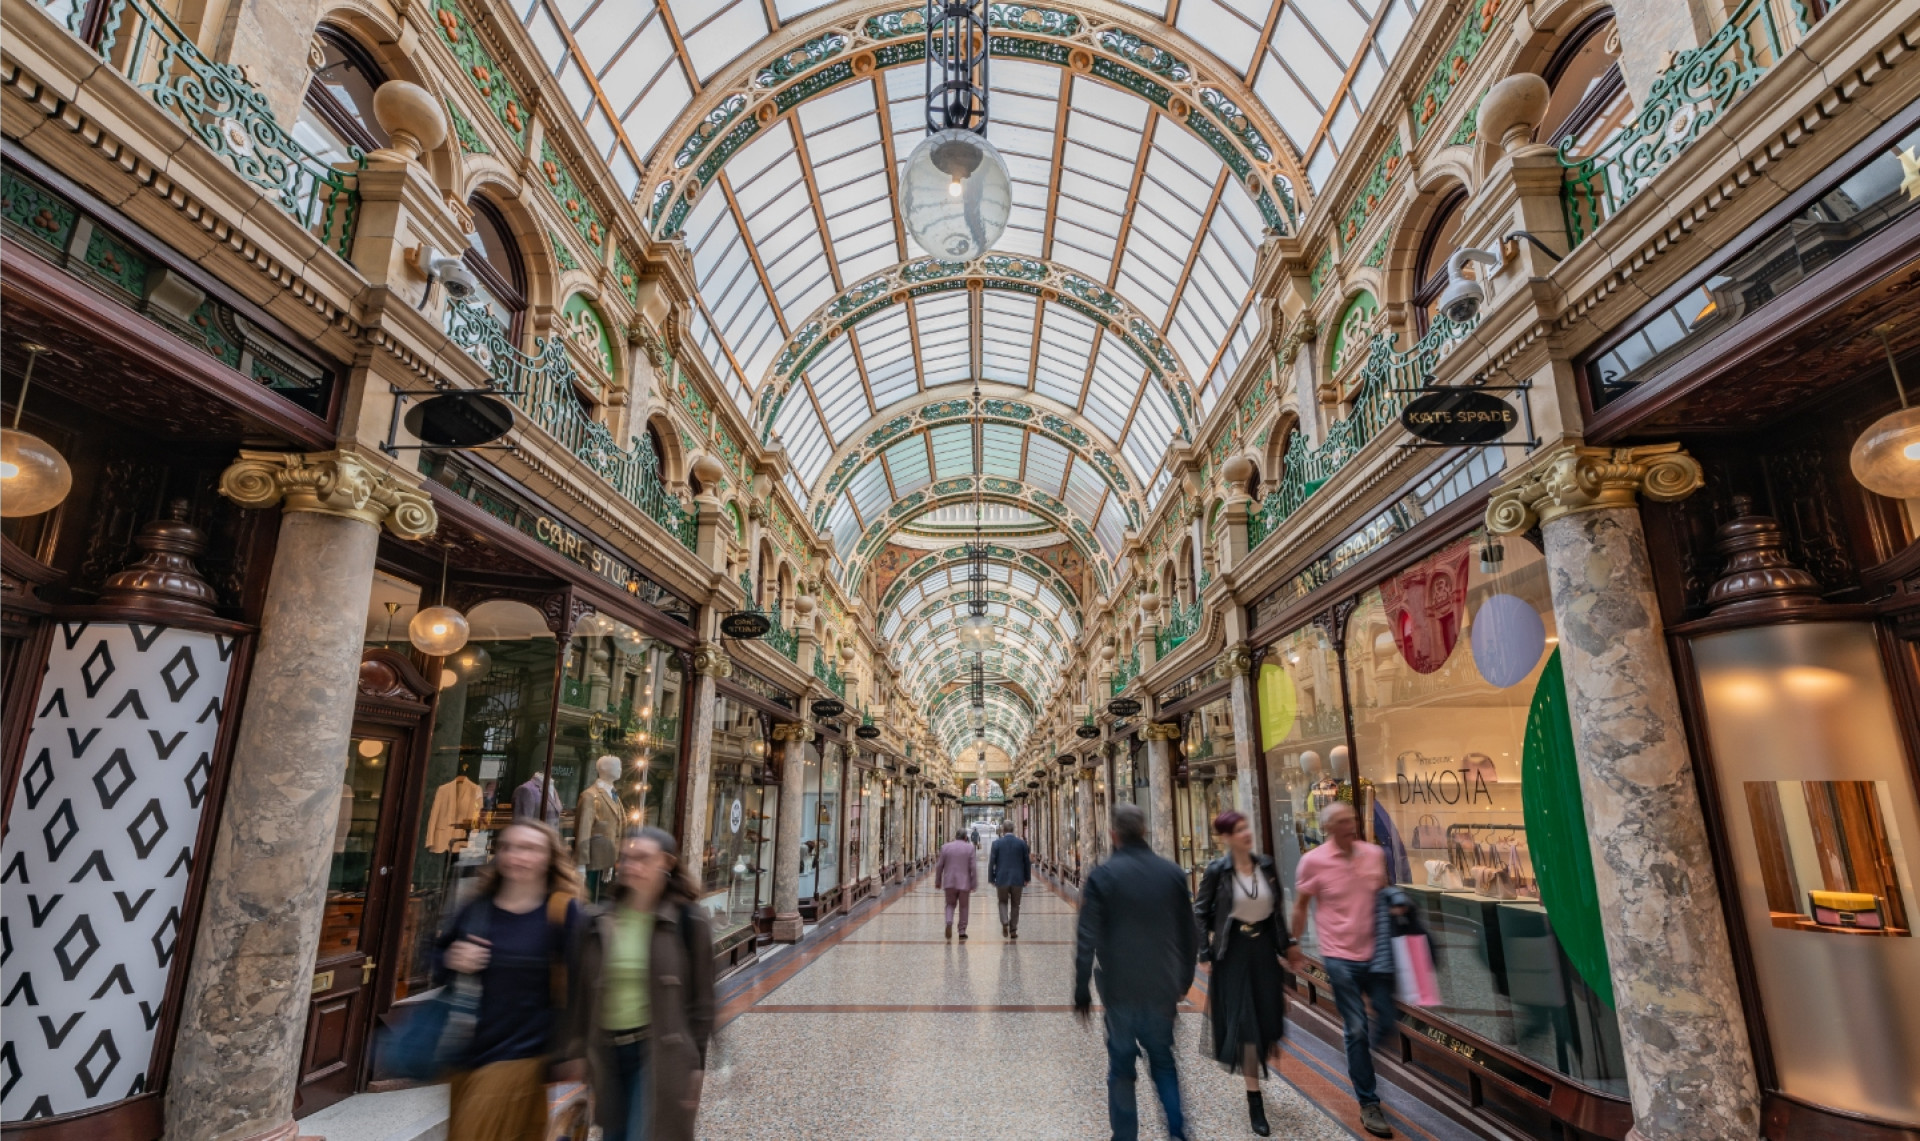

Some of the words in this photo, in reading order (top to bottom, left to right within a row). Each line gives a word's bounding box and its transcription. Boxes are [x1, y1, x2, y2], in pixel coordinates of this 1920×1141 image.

[1408, 411, 1453, 424] KATE
[1456, 409, 1512, 423] SPADE
[536, 516, 586, 564] CARL
[1335, 516, 1388, 571] SPADE
[1396, 769, 1493, 806] DAKOTA
